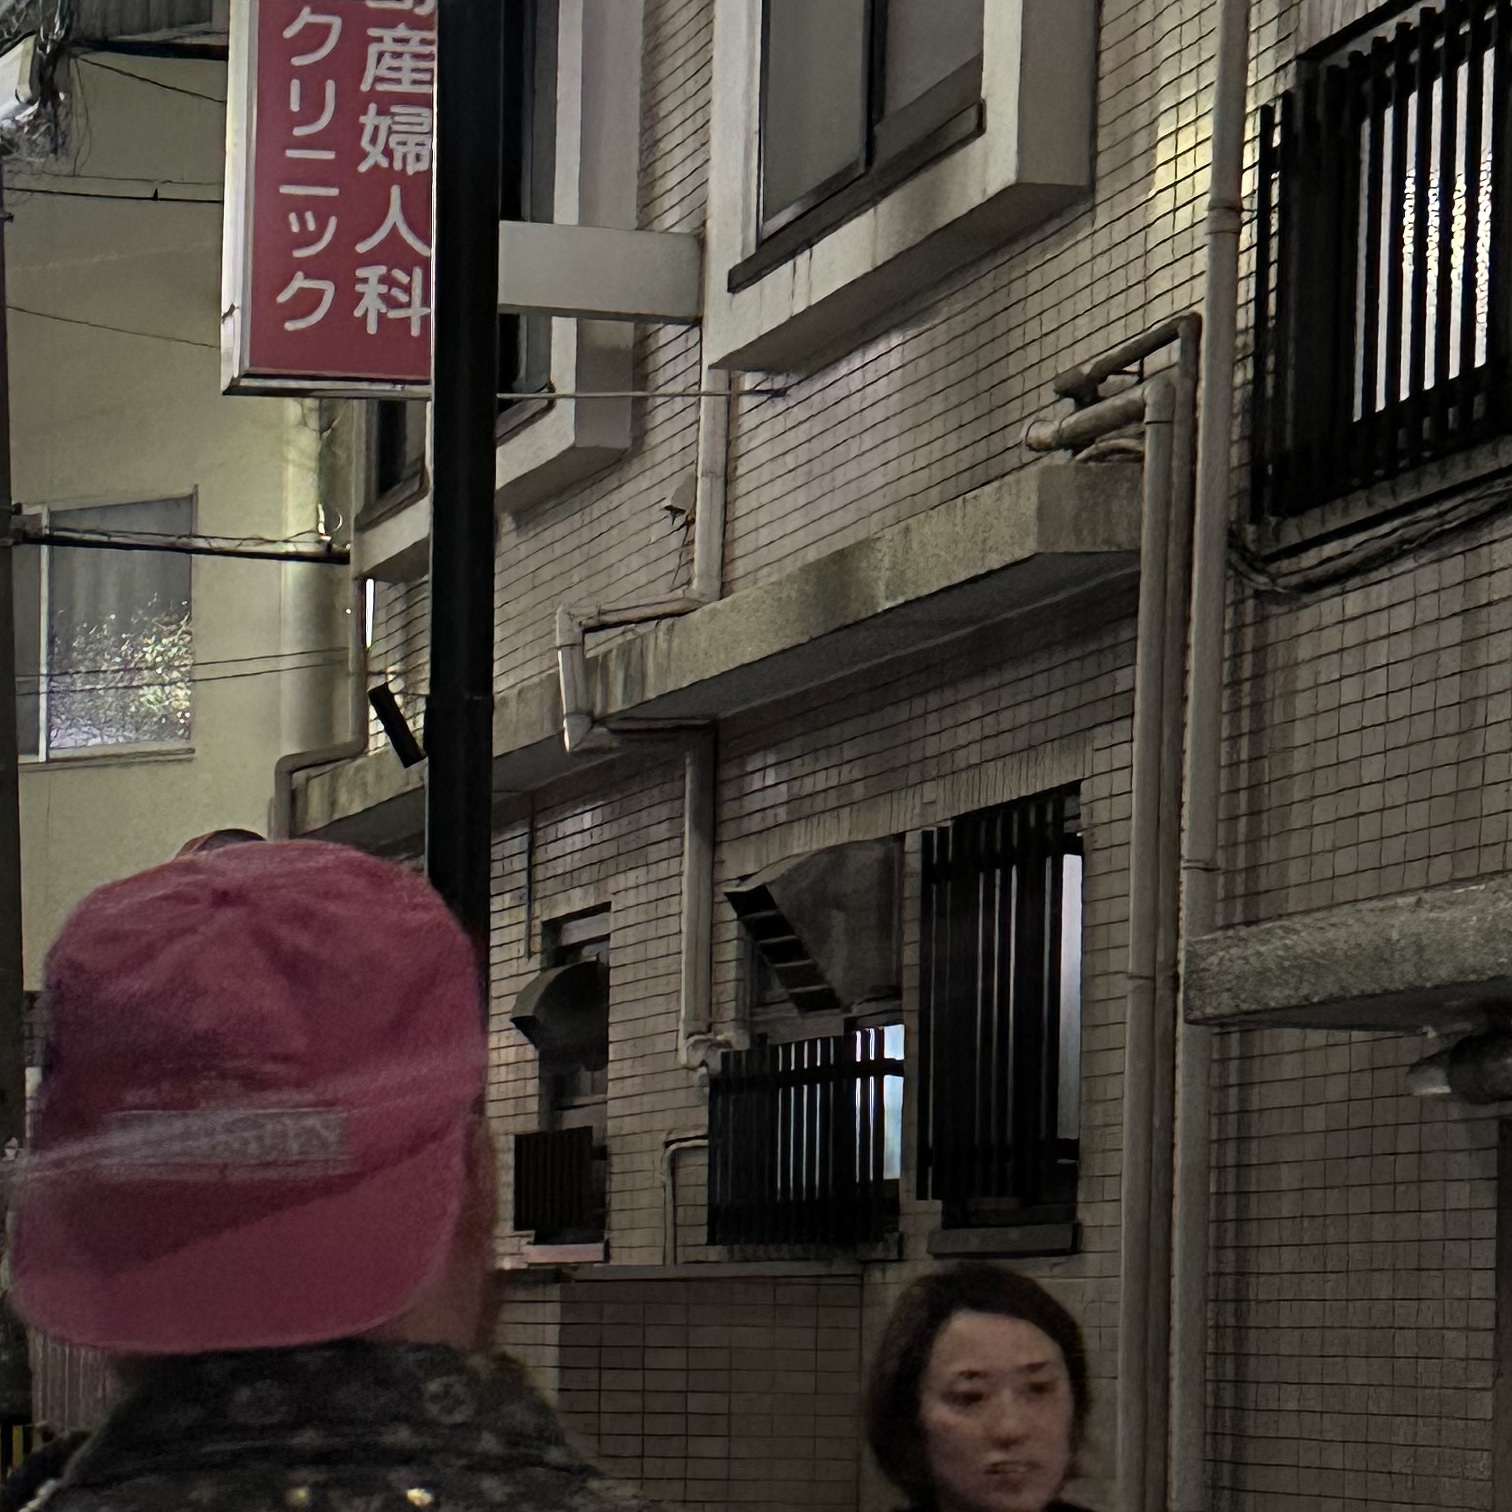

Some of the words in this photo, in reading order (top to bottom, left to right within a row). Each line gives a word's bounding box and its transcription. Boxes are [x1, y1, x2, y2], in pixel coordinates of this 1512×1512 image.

[276, 6, 343, 332] クリニック
[353, 0, 437, 338] 産婦人科
